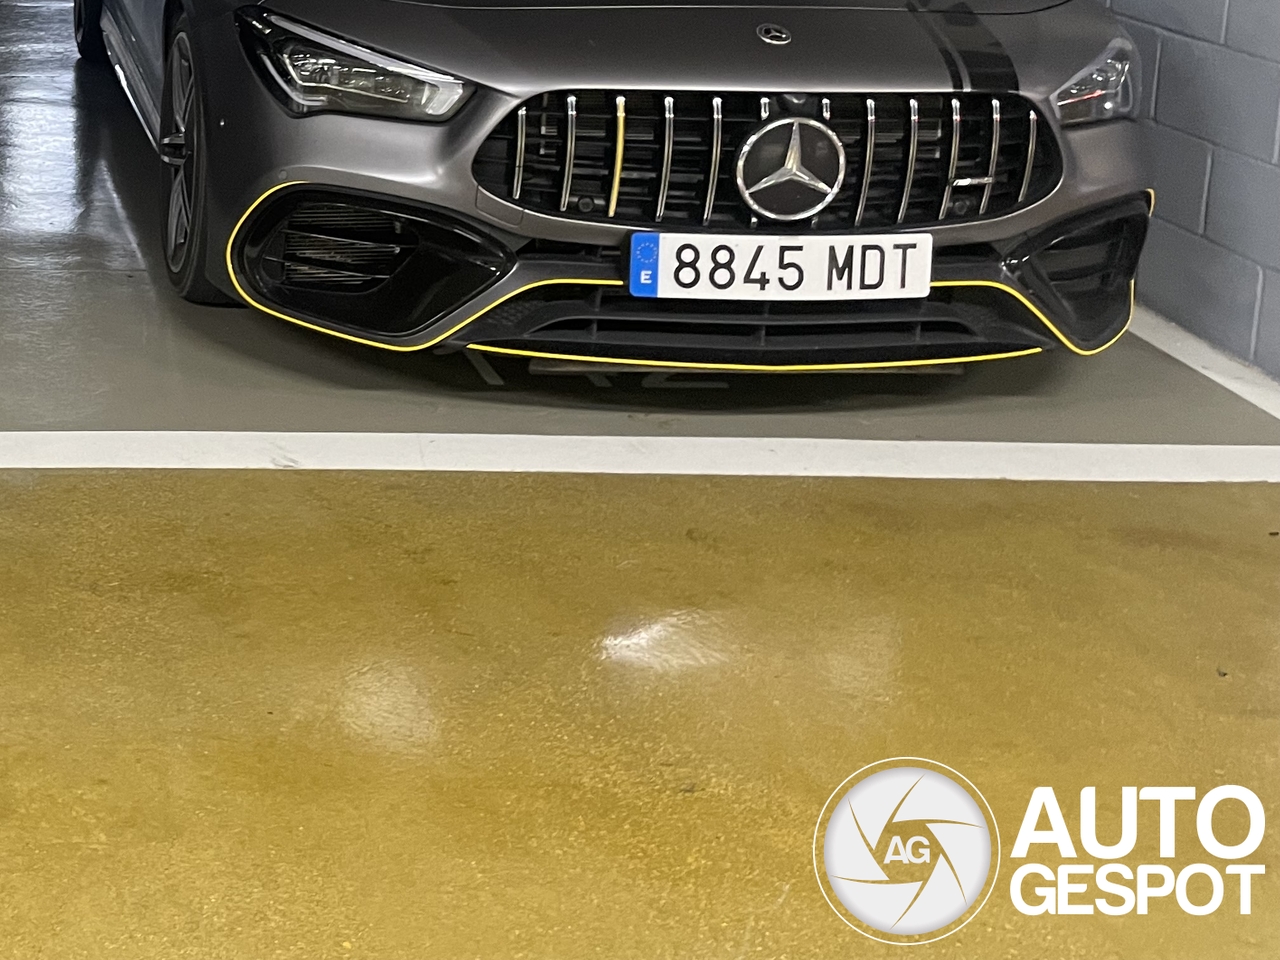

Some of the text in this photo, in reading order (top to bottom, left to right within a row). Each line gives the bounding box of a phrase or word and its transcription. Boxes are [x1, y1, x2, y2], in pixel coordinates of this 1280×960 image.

[640, 243, 917, 291] E 8845 MDT
